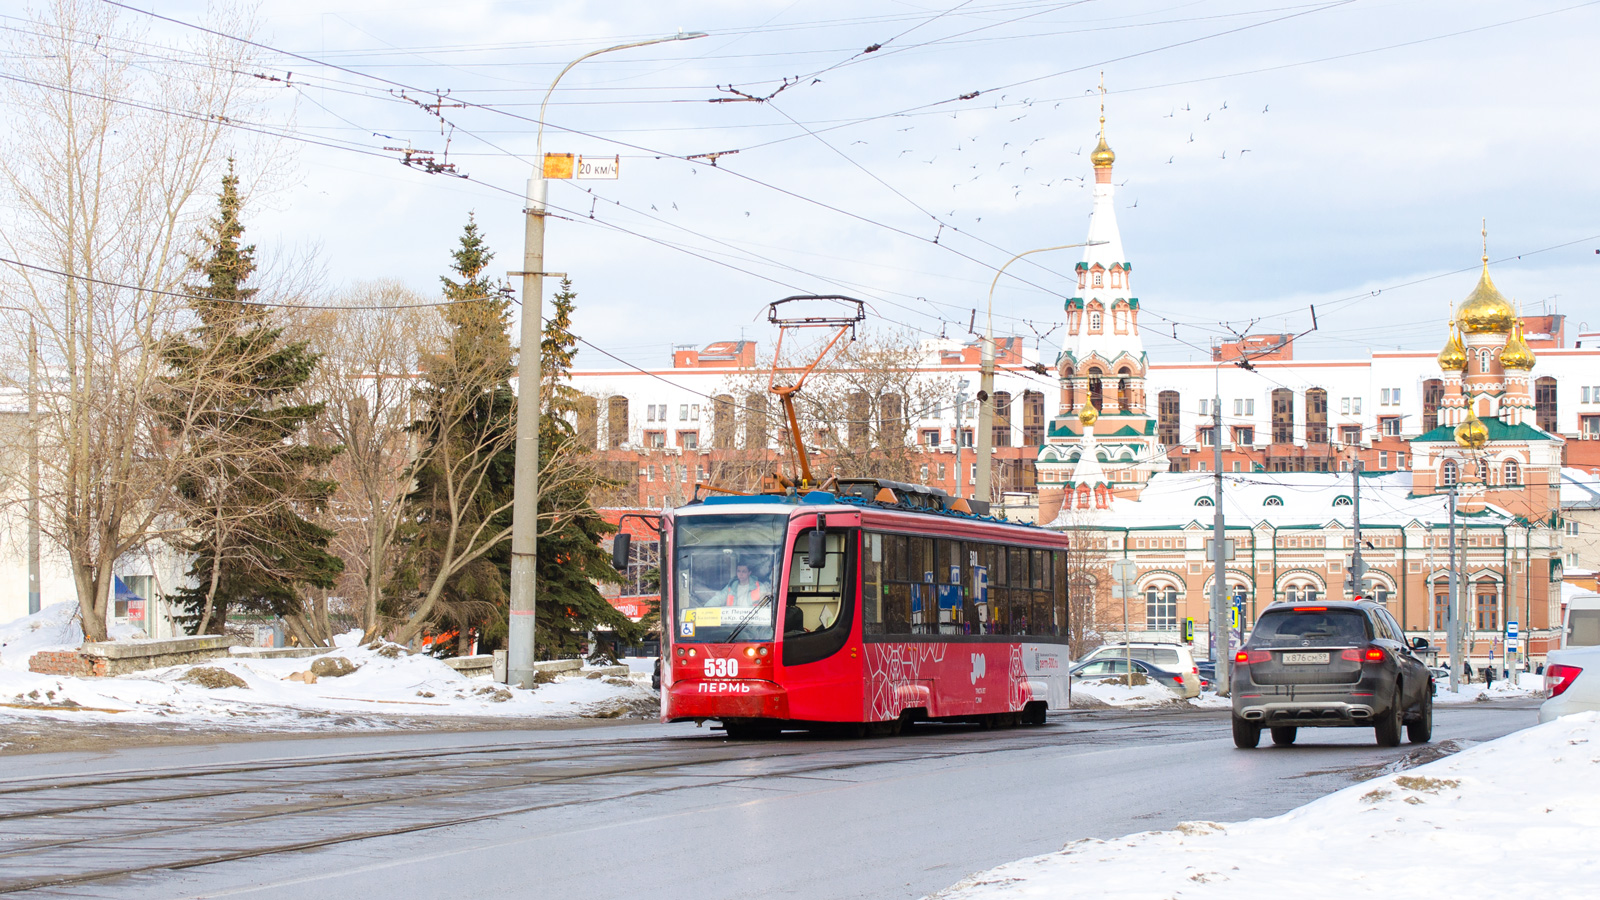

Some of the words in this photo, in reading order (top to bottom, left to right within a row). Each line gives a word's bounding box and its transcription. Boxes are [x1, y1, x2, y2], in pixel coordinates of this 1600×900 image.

[580, 163, 591, 174] 20
[594, 163, 616, 175] км/ч
[704, 658, 738, 677] 530
[698, 682, 750, 693] ПЕРМЬ
